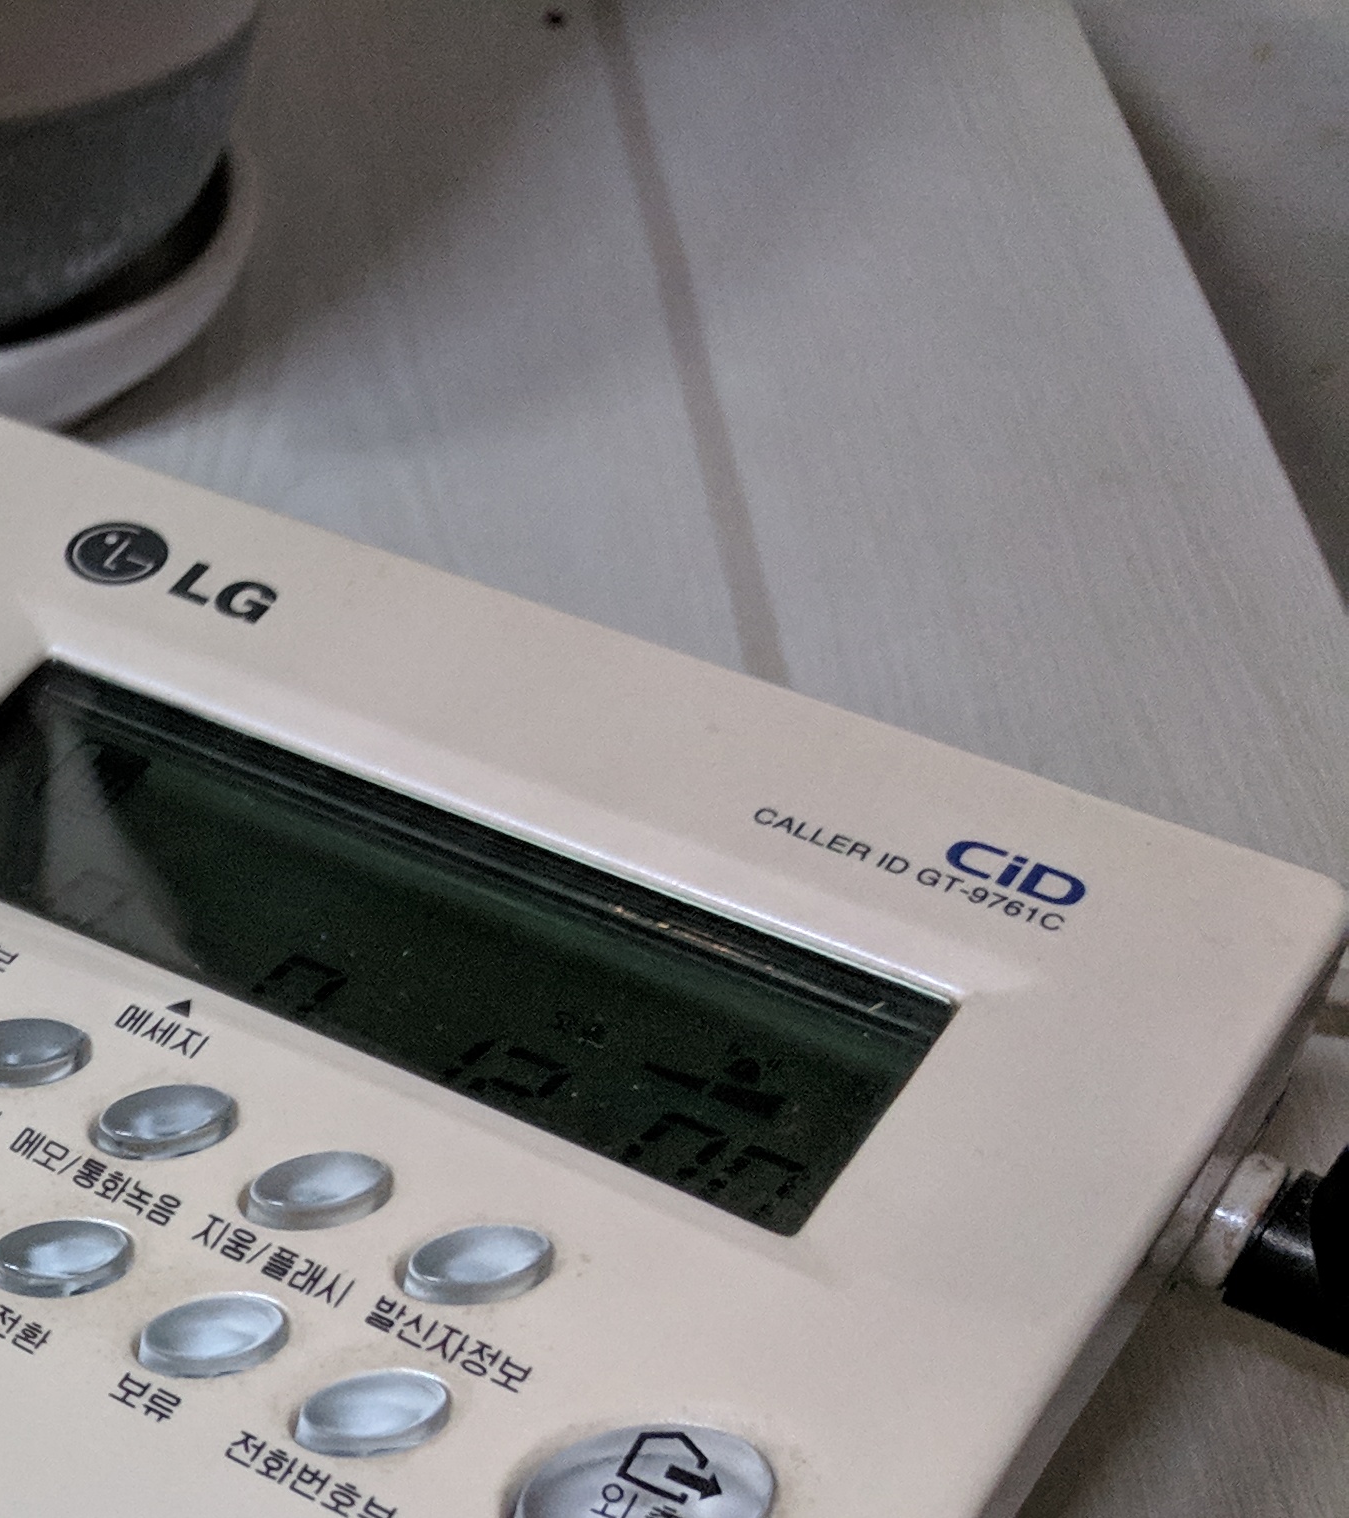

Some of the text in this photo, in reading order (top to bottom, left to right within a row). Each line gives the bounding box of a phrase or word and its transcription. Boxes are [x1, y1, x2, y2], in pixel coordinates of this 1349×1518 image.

[168, 561, 278, 624] LG
[752, 806, 1066, 933] CALLER ID GT-9761C
[113, 1002, 211, 1060] 메세지
[9, 1126, 182, 1227] 메모/통화녹음
[191, 1213, 357, 1310] 지움/플래시
[363, 1295, 535, 1395] 발신자정보
[108, 1371, 185, 1424] 보류
